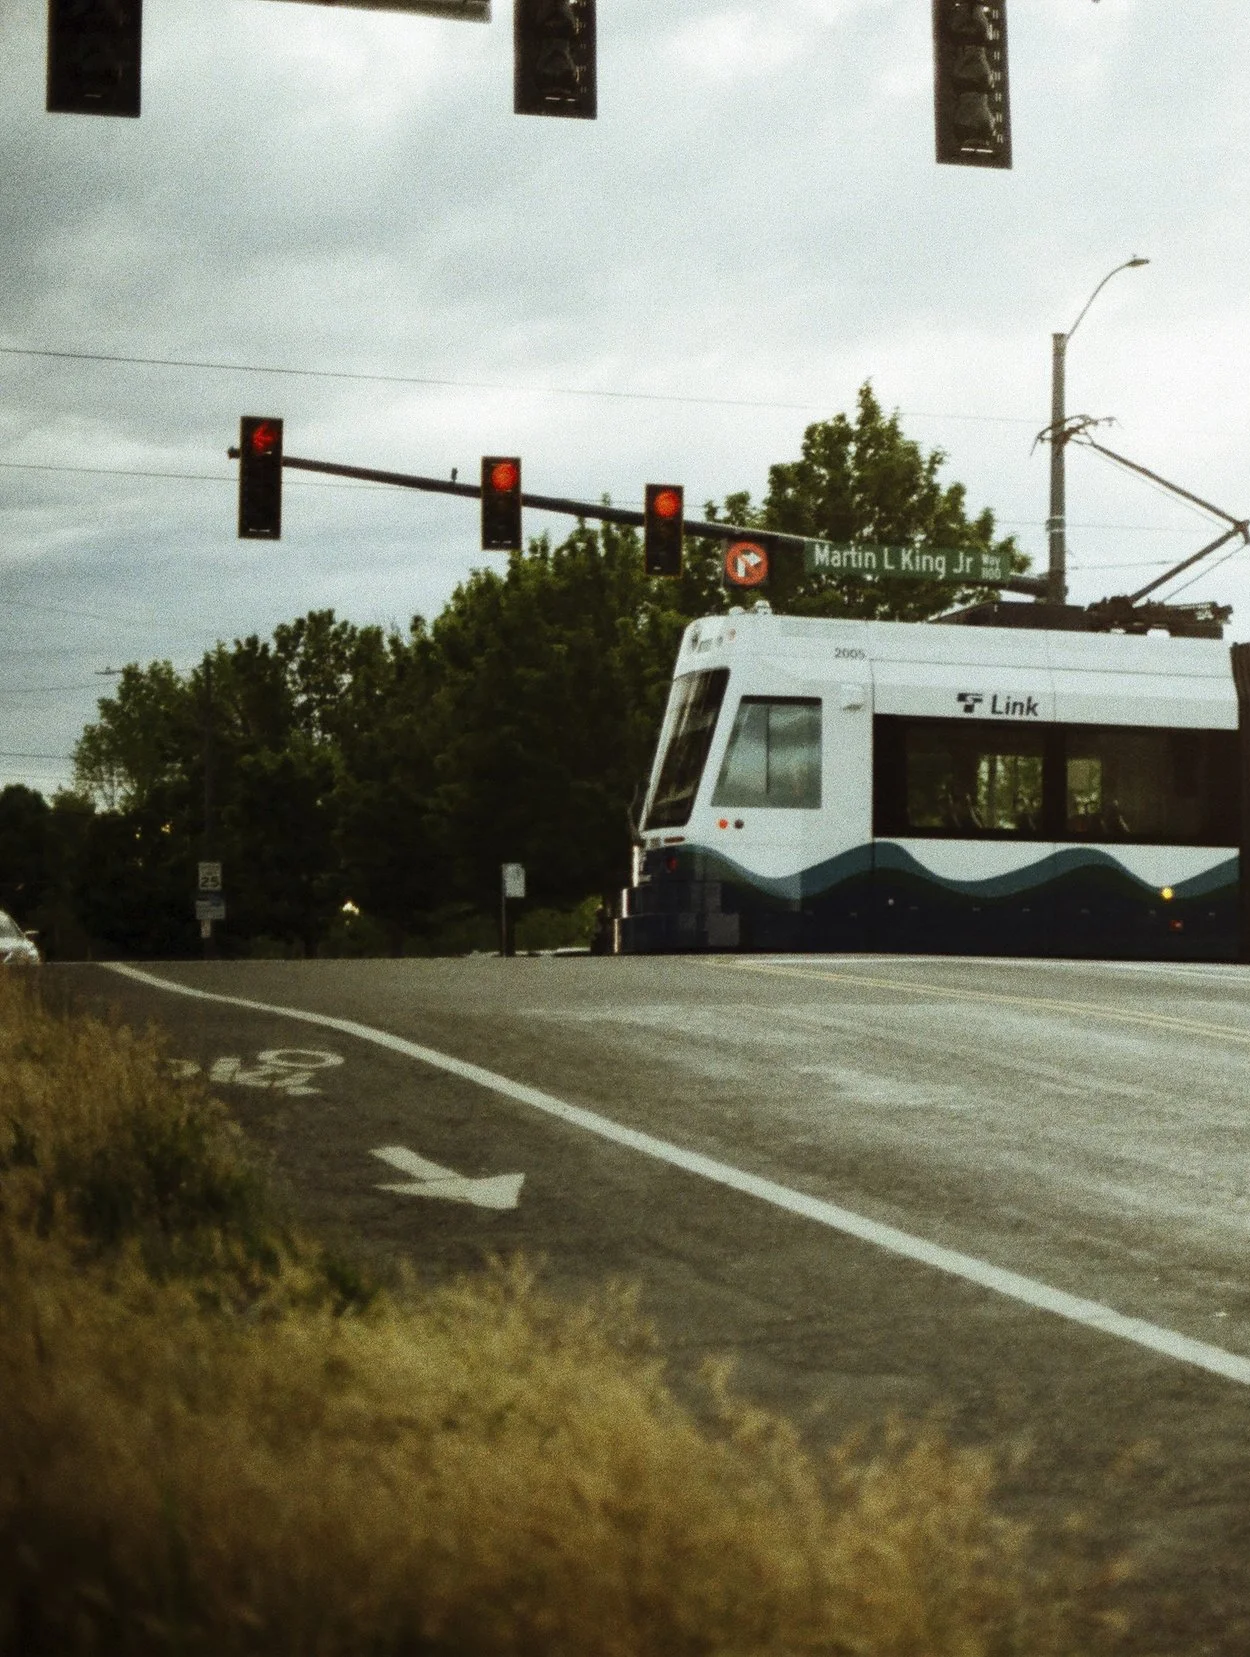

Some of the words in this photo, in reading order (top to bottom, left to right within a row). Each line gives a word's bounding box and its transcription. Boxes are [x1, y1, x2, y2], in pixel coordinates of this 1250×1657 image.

[814, 542, 876, 568] Martin
[884, 547, 895, 570] L
[901, 546, 946, 577] King
[953, 552, 973, 574] Jr
[991, 694, 1039, 717] Link
[201, 875, 220, 888] 25
